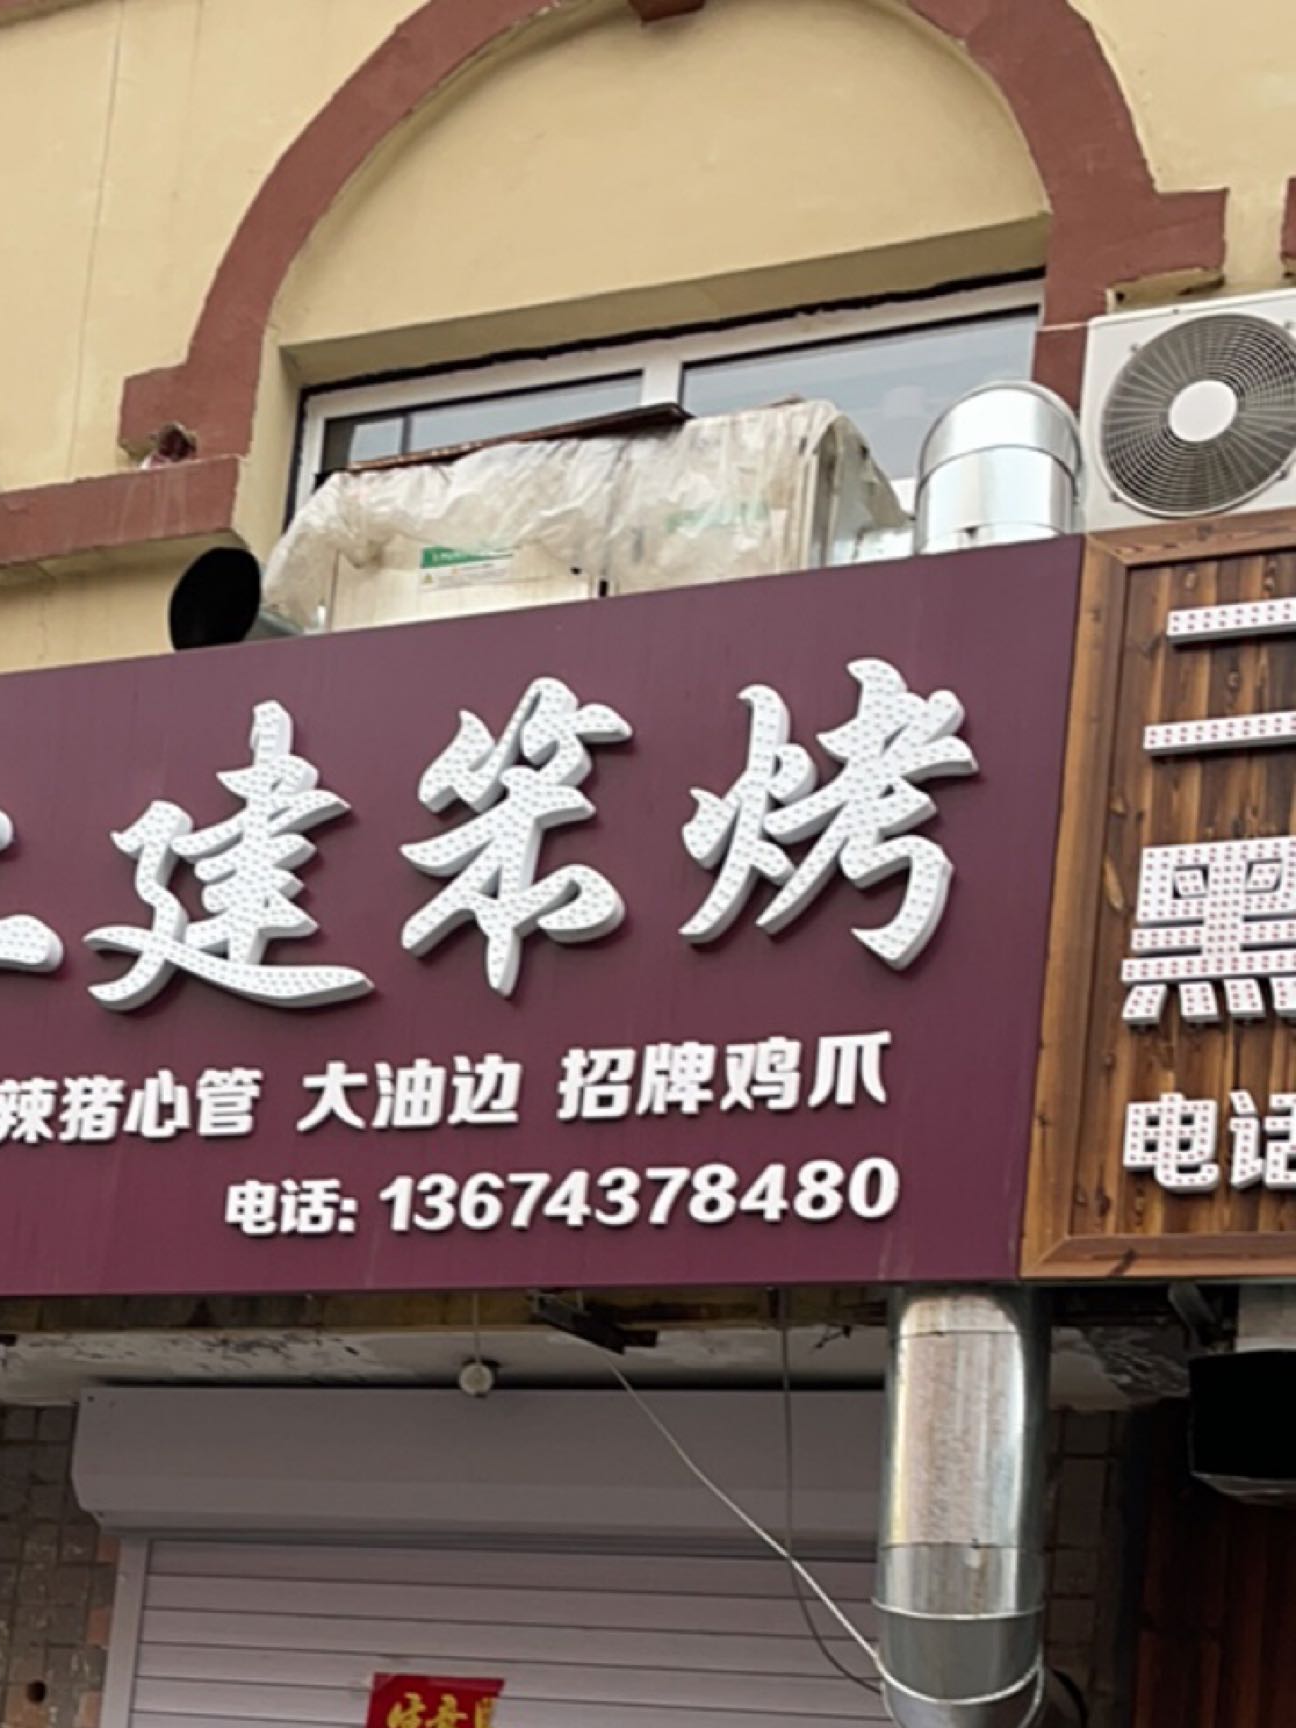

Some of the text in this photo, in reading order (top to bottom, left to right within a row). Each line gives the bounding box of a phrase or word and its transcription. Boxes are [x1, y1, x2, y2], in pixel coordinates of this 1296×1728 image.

[296, 1053, 522, 1132] 大油边
[557, 1030, 893, 1122] 招牌鸡爪
[377, 1156, 900, 1233] 13674378480
